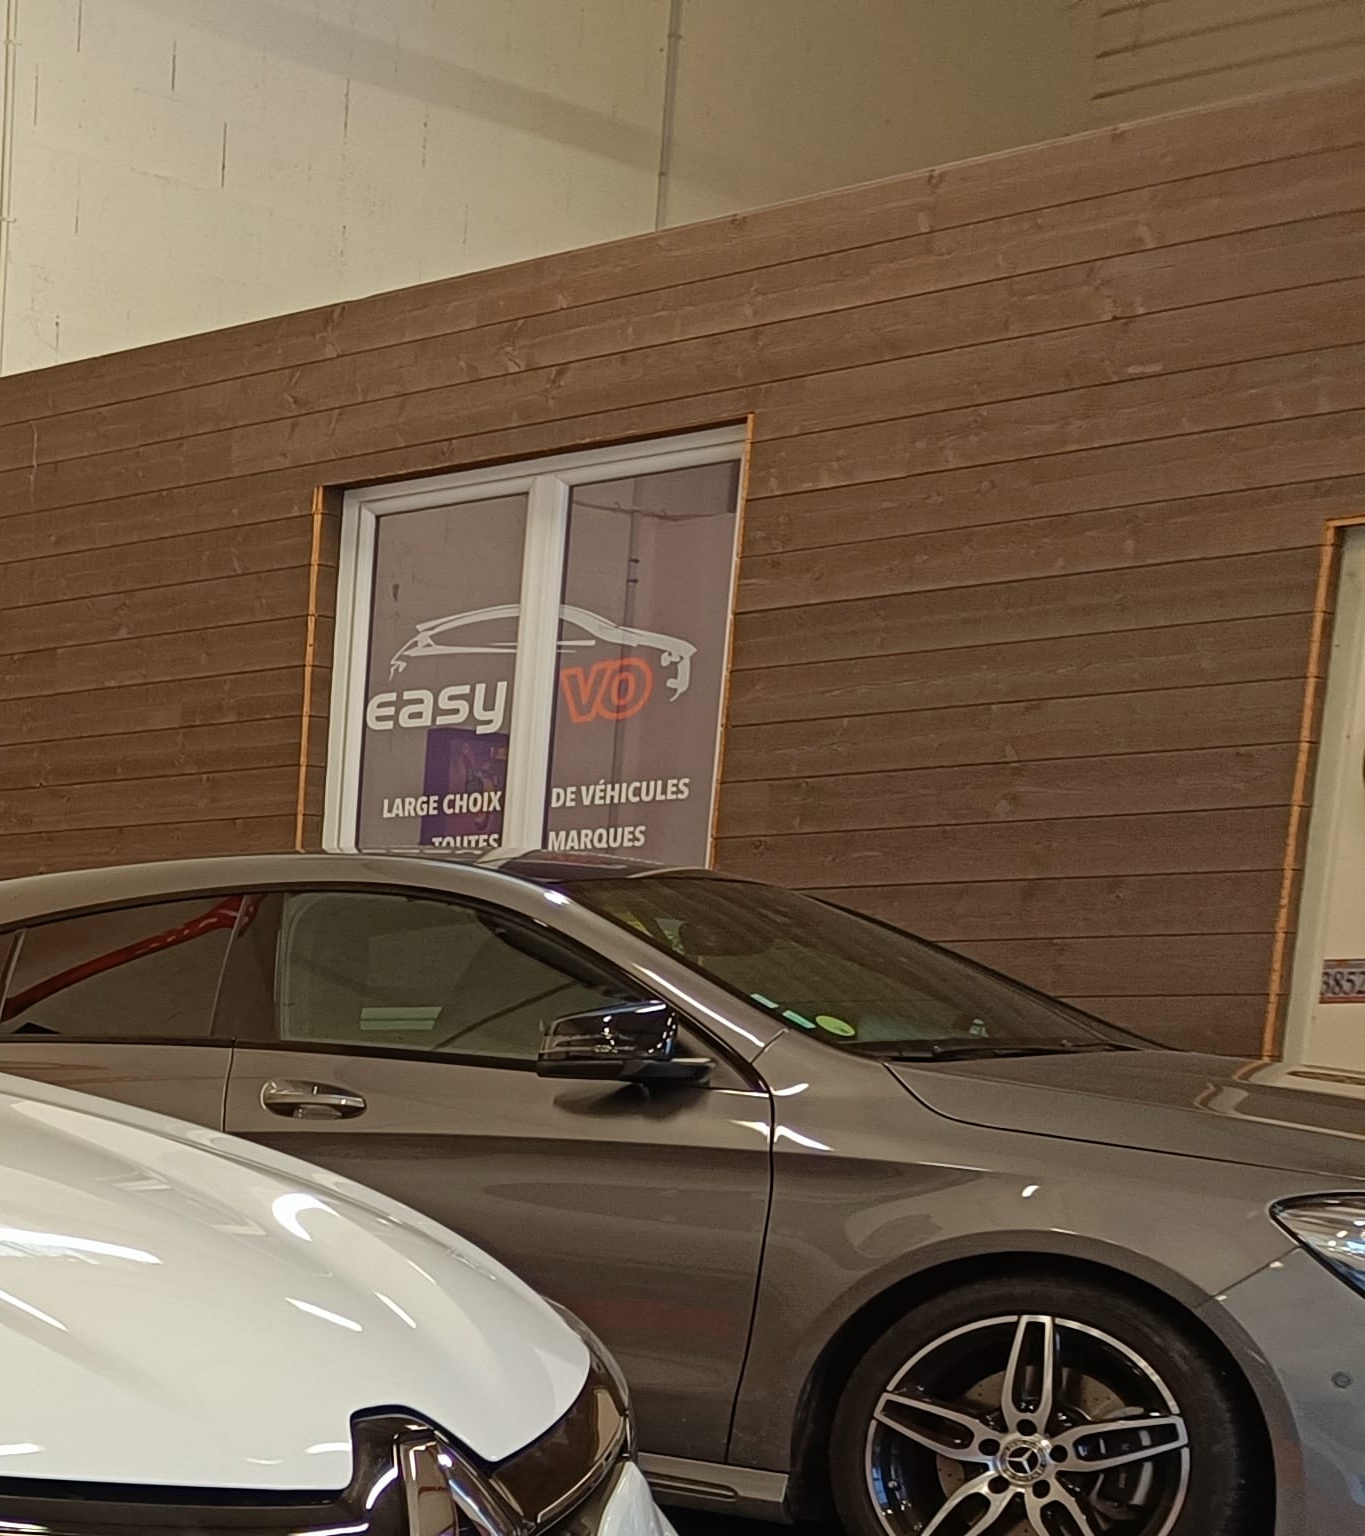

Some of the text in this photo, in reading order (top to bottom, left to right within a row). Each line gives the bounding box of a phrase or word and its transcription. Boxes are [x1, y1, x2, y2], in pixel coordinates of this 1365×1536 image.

[366, 657, 653, 735] easy VO
[382, 777, 690, 818] LARGE CHOIX DE VÉHICULES
[548, 825, 646, 851] MARQUES
